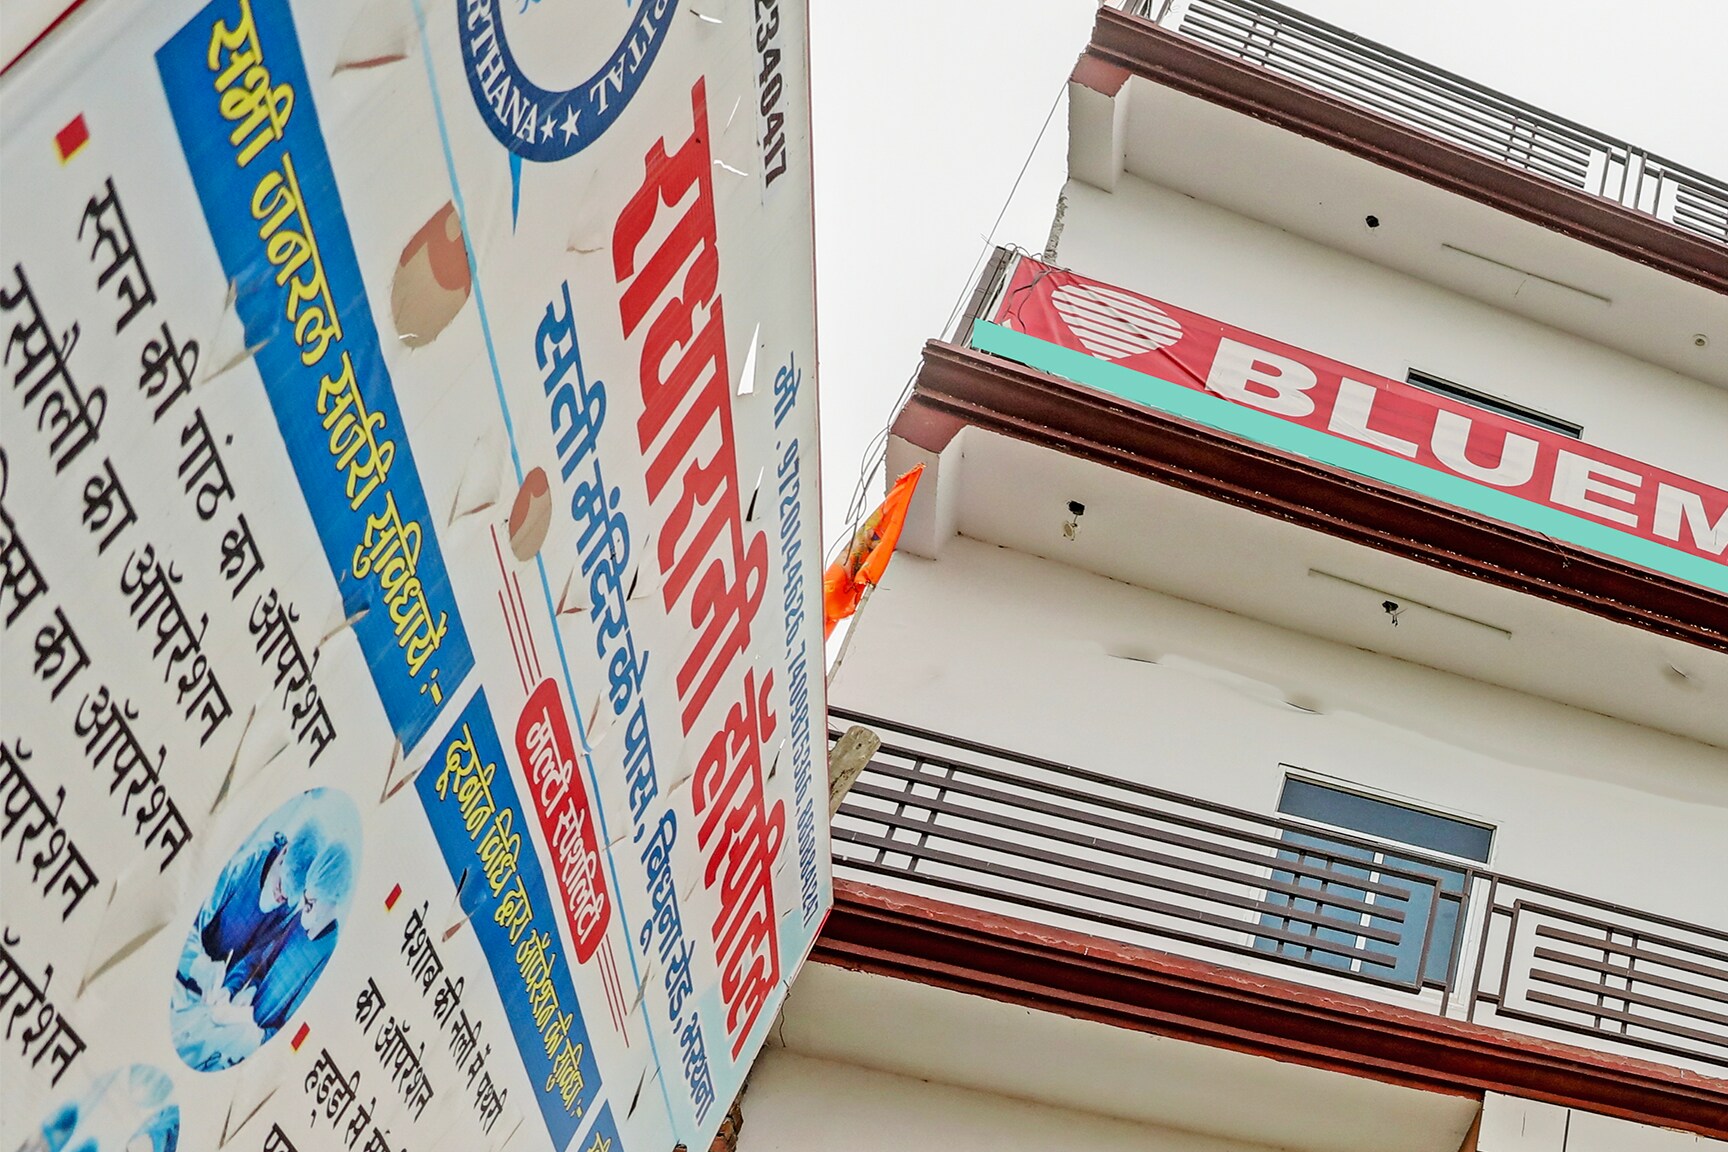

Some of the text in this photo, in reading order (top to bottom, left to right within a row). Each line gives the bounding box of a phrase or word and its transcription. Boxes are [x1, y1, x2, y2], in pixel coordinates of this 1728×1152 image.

[207, 0, 294, 167] सभी
[251, 152, 342, 365] जनरल
[77, 176, 337, 767] स्तन की गांठ का ऑपरेशन
[316, 351, 394, 510] सर्जरी
[81, 456, 138, 555] का
[119, 543, 233, 747] ऑपरेशन
[351, 491, 447, 676] सुविधायें
[611, 76, 785, 1059] राधारानी हॉस्पीटल
[33, 605, 193, 873] का ऑपरेशन
[435, 723, 495, 839] दूरबीन
[534, 281, 606, 480] सती
[570, 459, 630, 657] मंदिर
[607, 630, 649, 715] के
[639, 808, 683, 961] बिधूना
[679, 1011, 715, 1126] भरथना
[476, 807, 520, 897] विधि
[525, 683, 610, 945] मल्टी स्पेशलिटी
[493, 876, 533, 944] द्वारा
[515, 929, 559, 1030] ऑपरेशन
[303, 1047, 360, 1129] हड्डी
[343, 1096, 376, 1151] से
[354, 976, 434, 1122] का ऑपरेशन
[400, 899, 507, 1135] पेशाब की नली में पथरी
[543, 1011, 573, 1058] की
[545, 1038, 583, 1109] सुविधा
